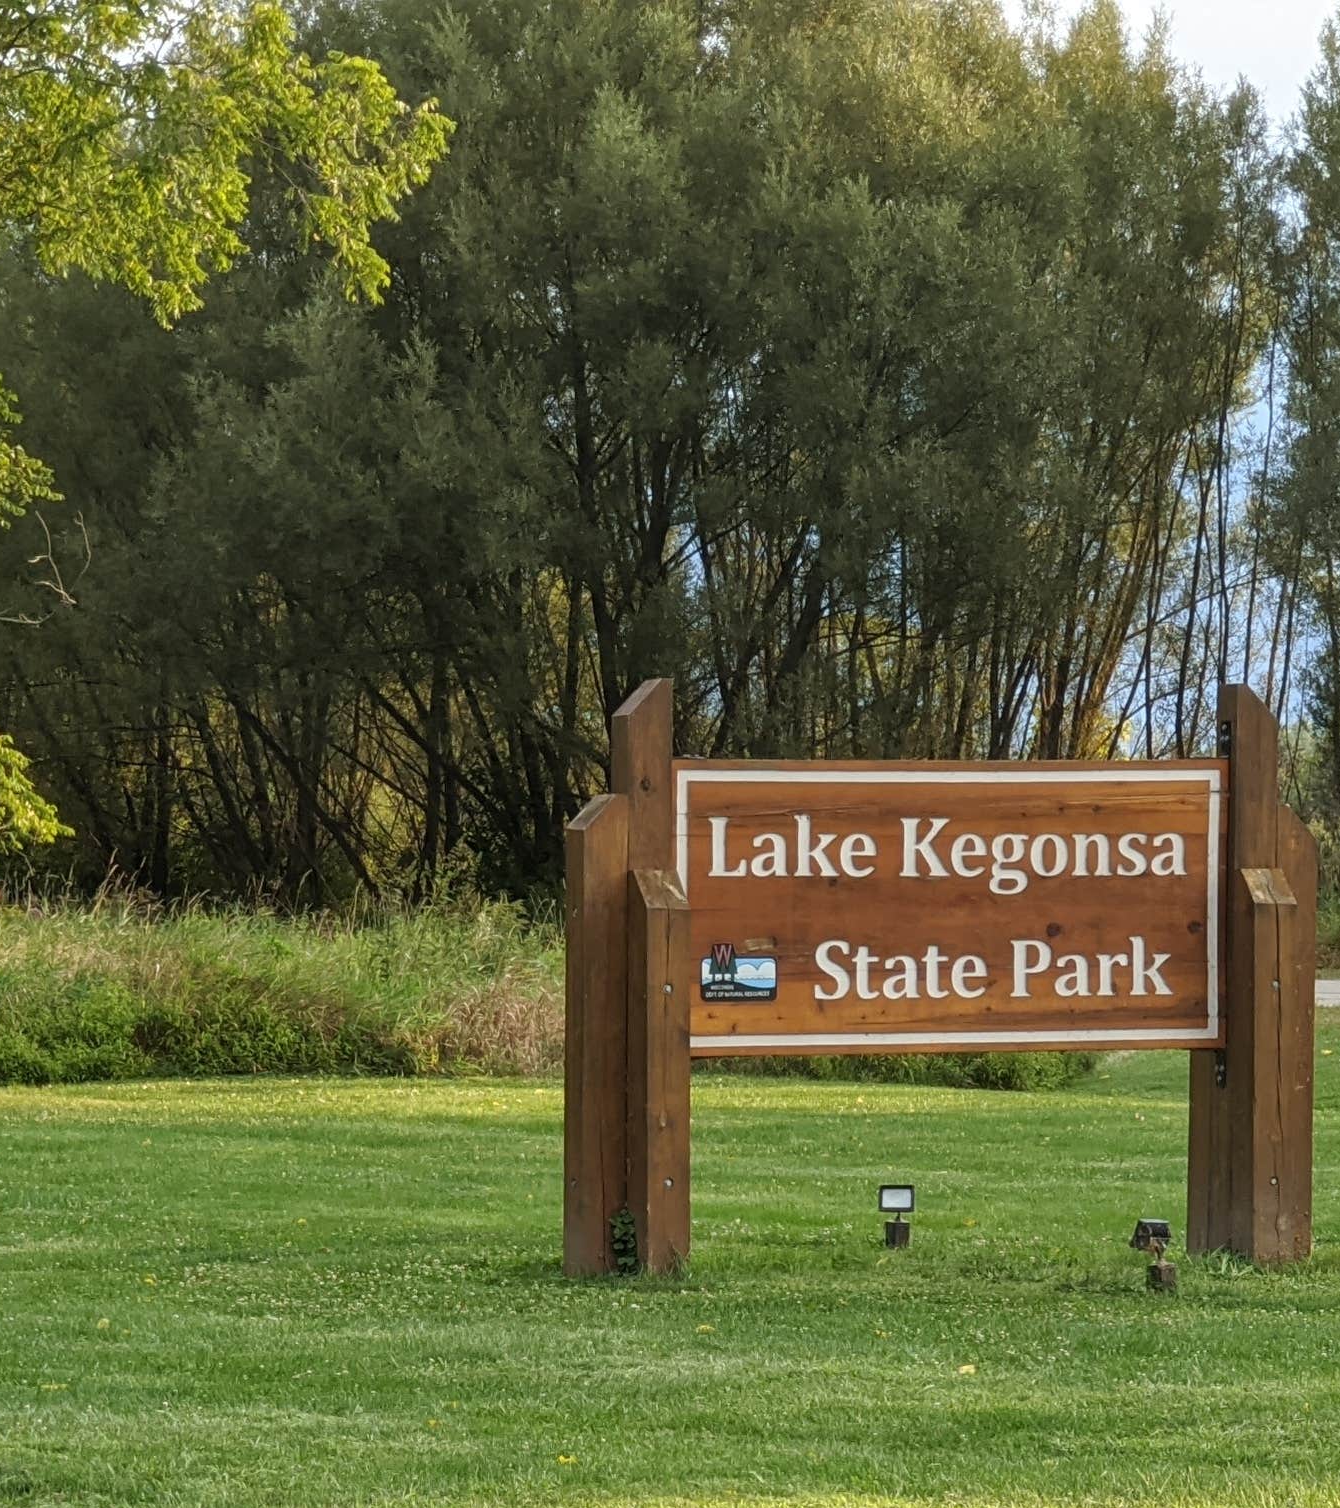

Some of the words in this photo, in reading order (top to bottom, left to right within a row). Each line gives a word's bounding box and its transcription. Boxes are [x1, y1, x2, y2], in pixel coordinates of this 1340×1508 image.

[708, 813, 878, 878] Lake
[899, 816, 1189, 895] Kegonsa
[814, 939, 990, 1001] State
[1010, 938, 1173, 999] Park
